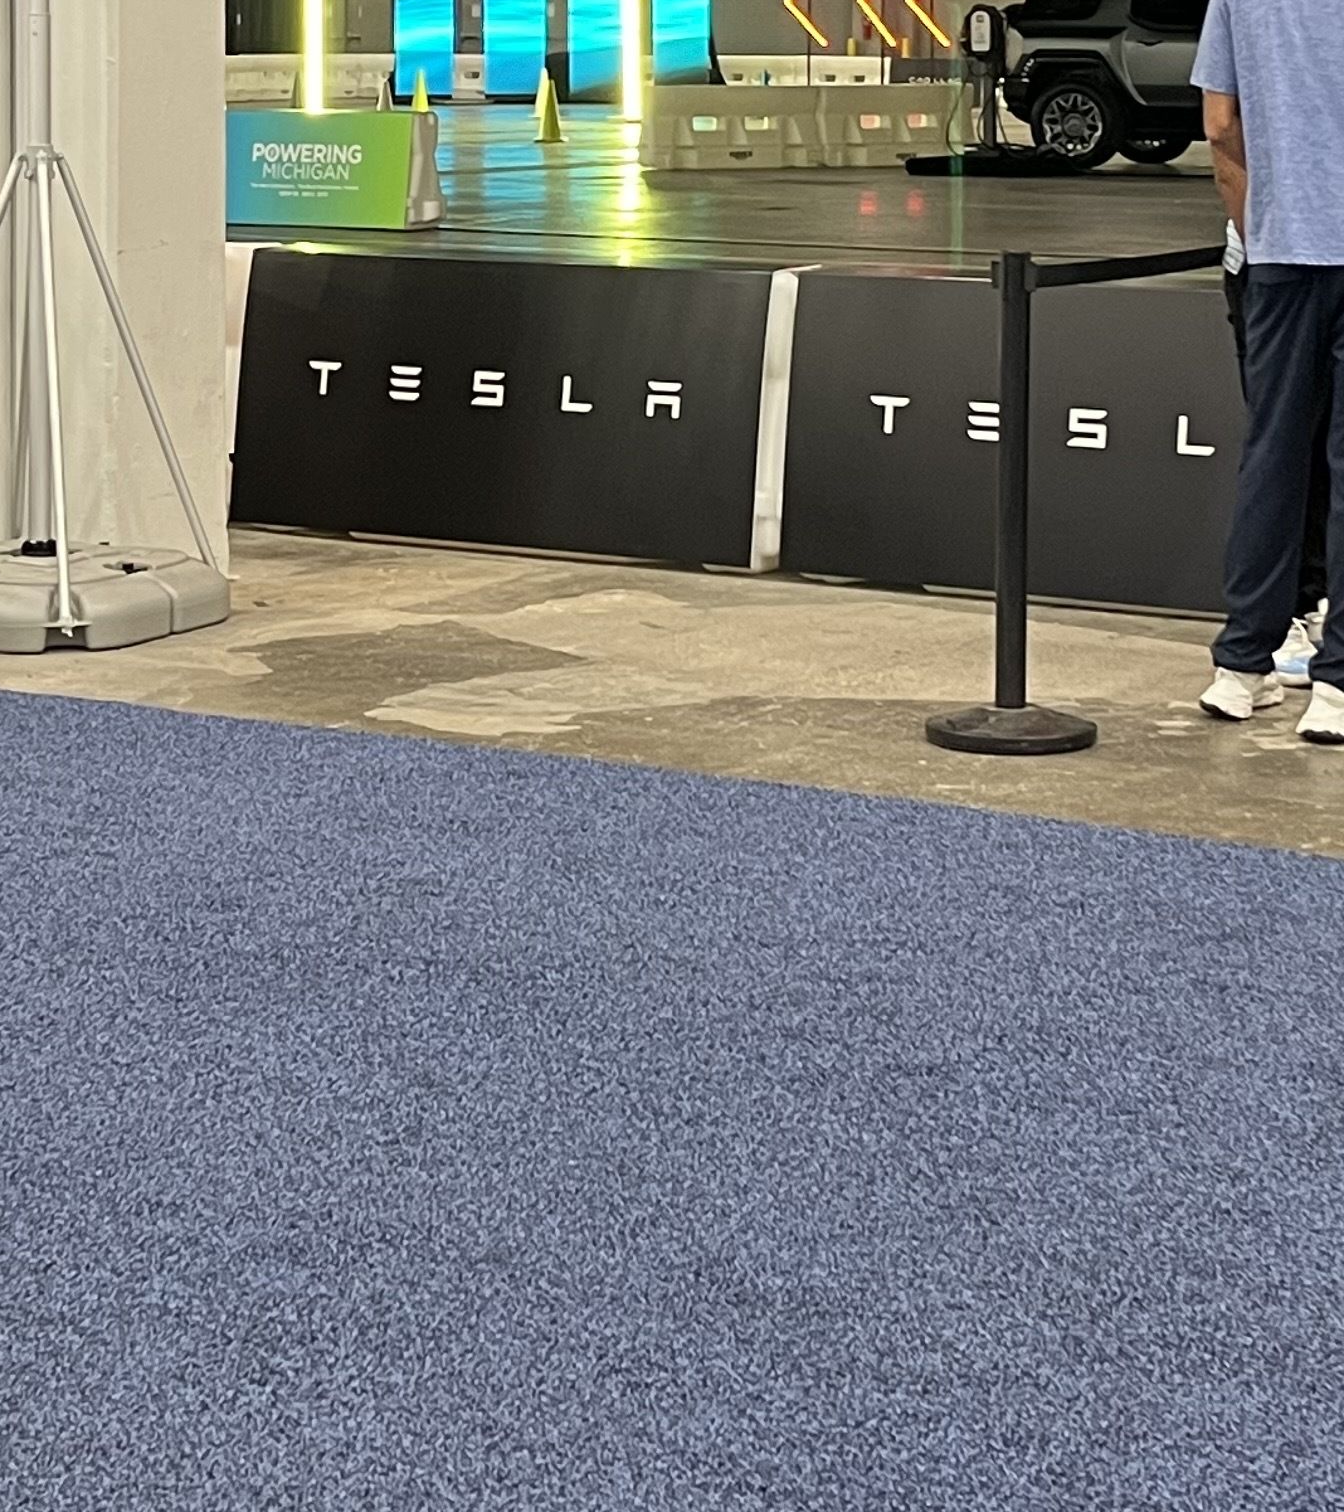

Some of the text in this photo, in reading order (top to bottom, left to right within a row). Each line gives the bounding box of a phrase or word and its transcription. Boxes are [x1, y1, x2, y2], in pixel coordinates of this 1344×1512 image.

[252, 143, 362, 164] POWERING
[262, 162, 350, 180] MICHIGAN
[308, 360, 683, 420] TESLA
[869, 394, 1216, 457] TESL
